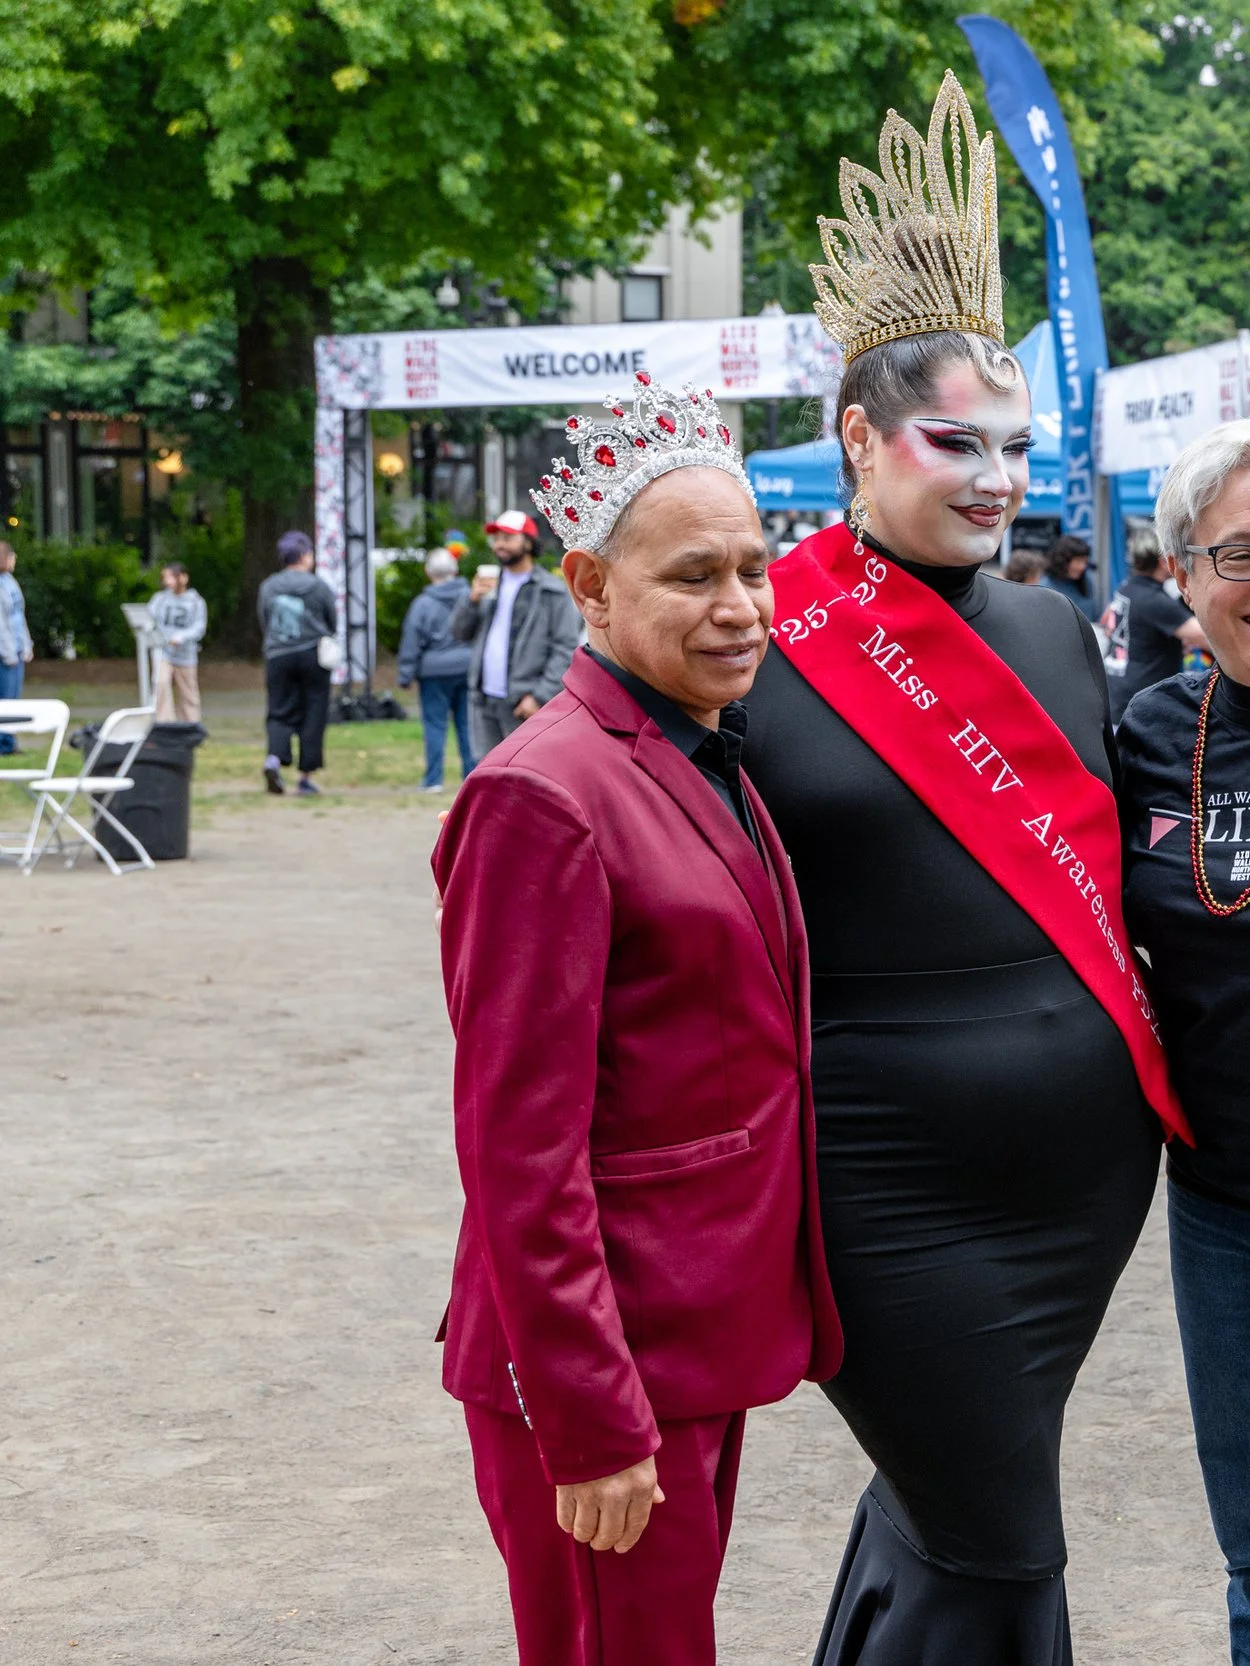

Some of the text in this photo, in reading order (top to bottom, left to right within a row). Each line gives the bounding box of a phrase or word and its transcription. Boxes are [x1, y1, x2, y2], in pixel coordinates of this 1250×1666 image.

[504, 349, 647, 379] WELCOME
[1064, 450, 1095, 544] ISER
[858, 624, 938, 710] Miss
[949, 719, 1024, 793] HIV
[1021, 812, 1125, 973] Awareness
[1207, 792, 1232, 807] ALL
